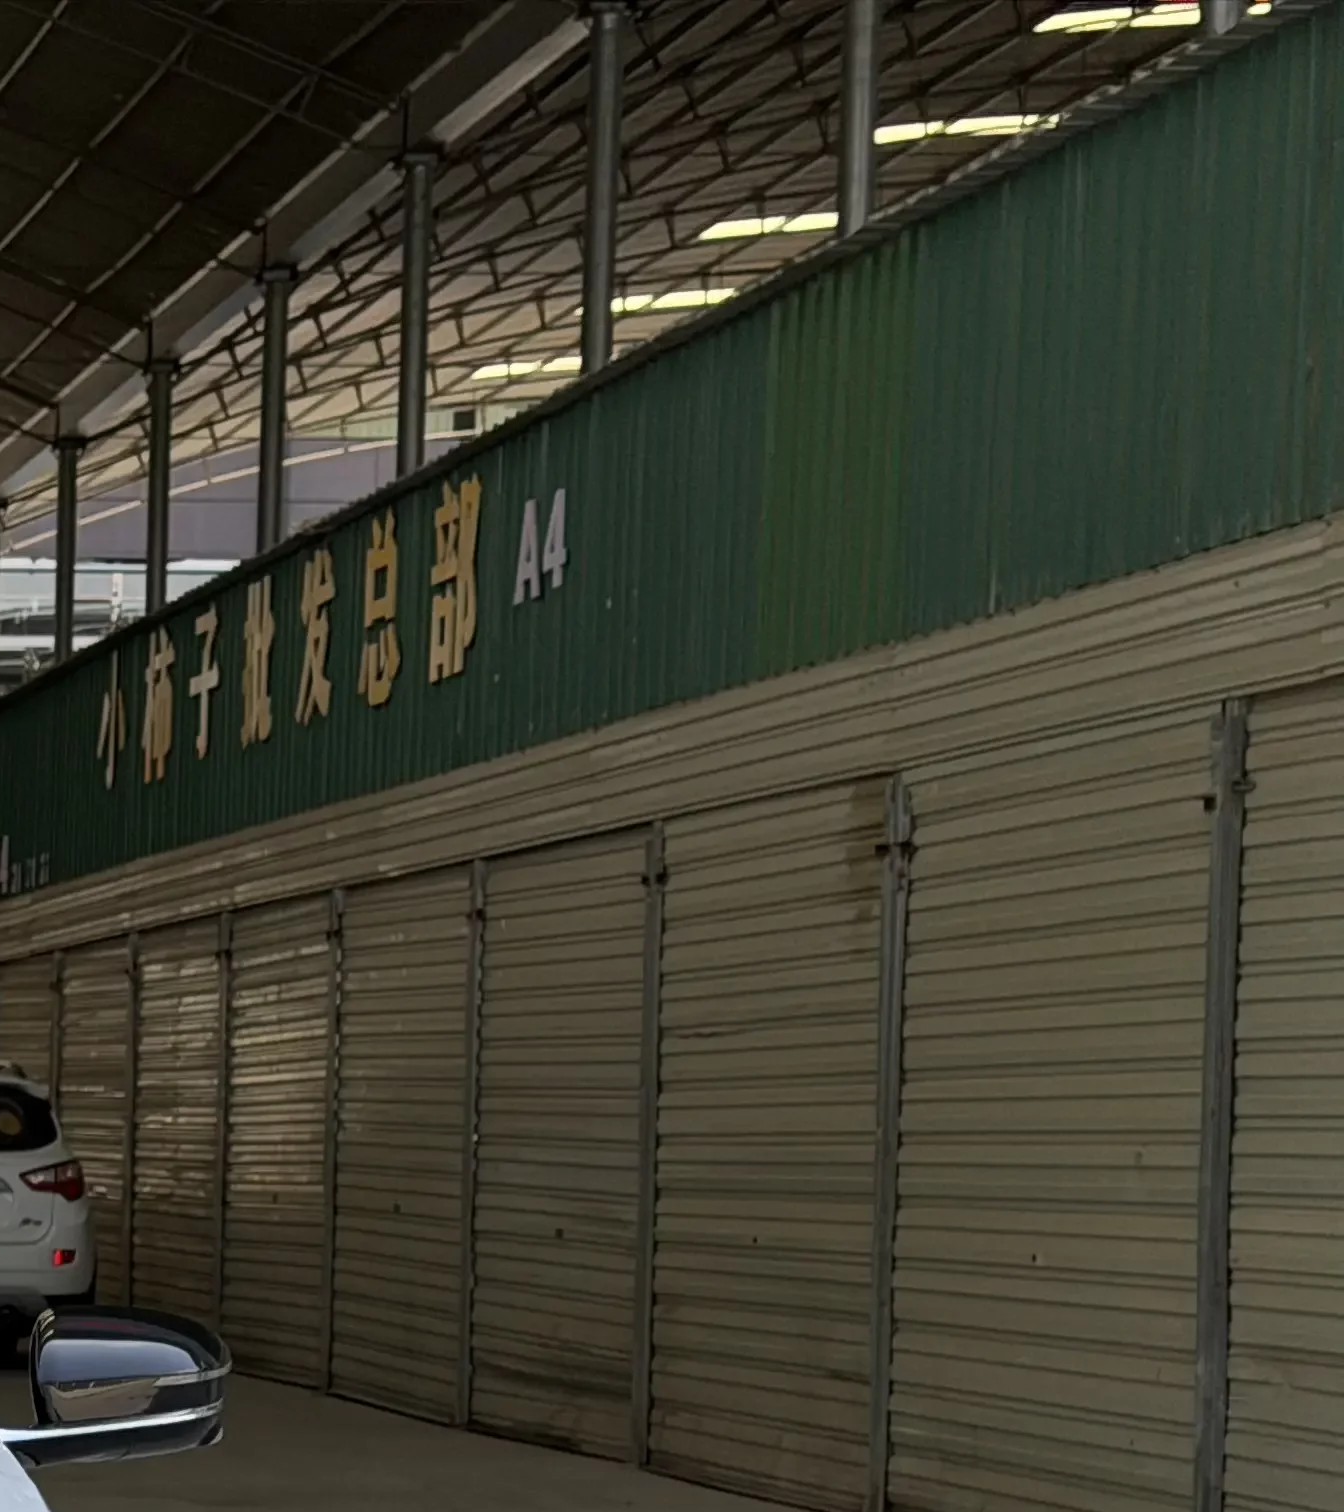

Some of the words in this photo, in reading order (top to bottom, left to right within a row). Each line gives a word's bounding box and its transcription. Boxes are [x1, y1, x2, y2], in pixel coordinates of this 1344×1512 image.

[96, 472, 482, 791] 小柿子批发总部
[513, 487, 569, 606] A4
